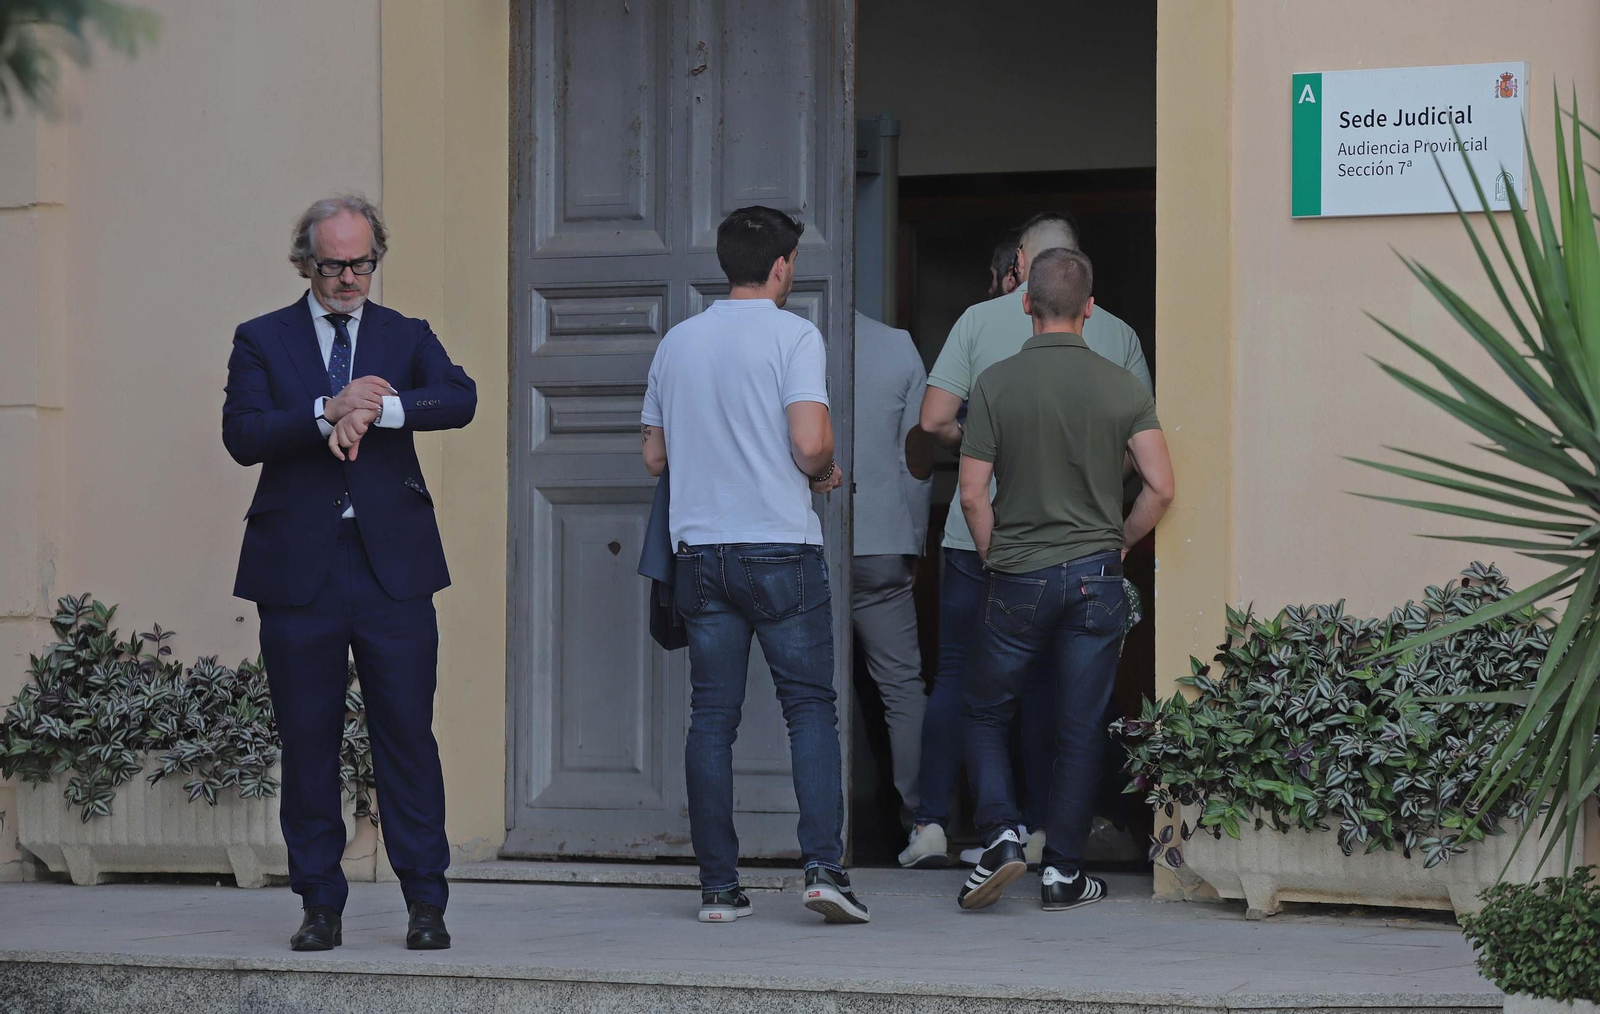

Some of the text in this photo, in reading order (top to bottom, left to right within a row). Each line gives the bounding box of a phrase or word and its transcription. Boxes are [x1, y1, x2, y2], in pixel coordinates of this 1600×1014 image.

[1298, 84, 1316, 104] A
[1339, 105, 1472, 129] Sede Judicial
[1337, 136, 1488, 156] Audiencia Provincial
[1338, 159, 1413, 177] Sección 7ª
